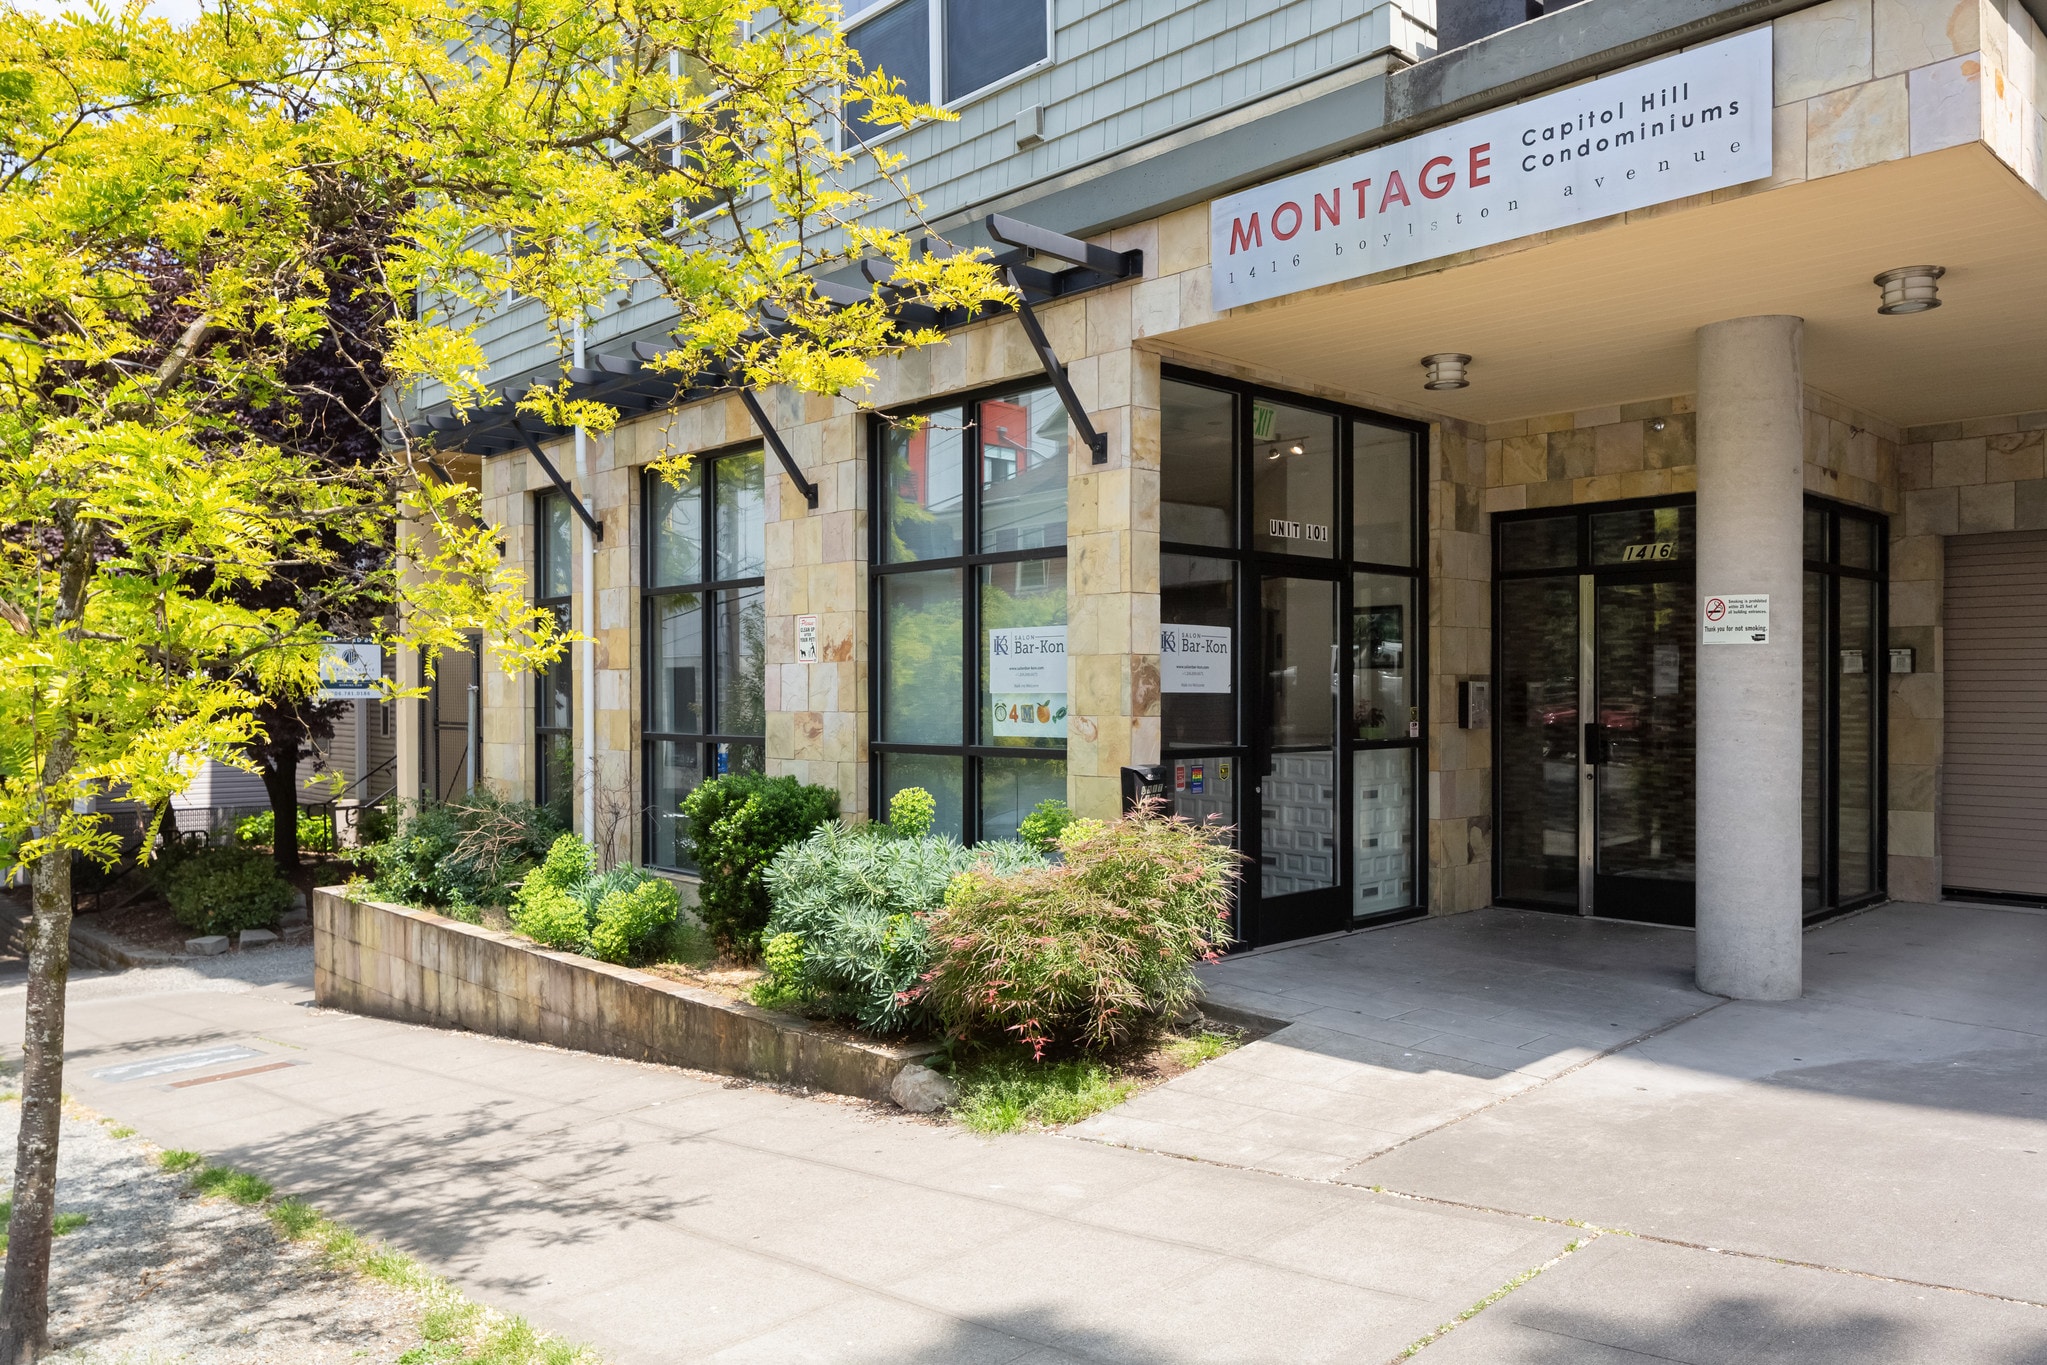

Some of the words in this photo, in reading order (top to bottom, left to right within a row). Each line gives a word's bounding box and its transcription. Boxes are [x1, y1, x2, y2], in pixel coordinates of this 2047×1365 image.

[1521, 101, 1624, 147] Capitol
[1641, 82, 1689, 113] Hill
[1521, 100, 1740, 172] Condominiums
[1229, 142, 1491, 256] MONTAGE
[1228, 253, 1301, 284] 1416
[1334, 198, 1519, 257] boylston
[1562, 140, 1741, 197] avenue
[1270, 519, 1299, 538] UNIT
[1306, 525, 1327, 541] 101
[1627, 543, 1671, 561] 1416
[1704, 625, 1716, 633] Thank
[1745, 624, 1768, 633] smoking.
[1014, 639, 1065, 655] Bar-Kon
[1181, 638, 1228, 654] Bar-Kon
